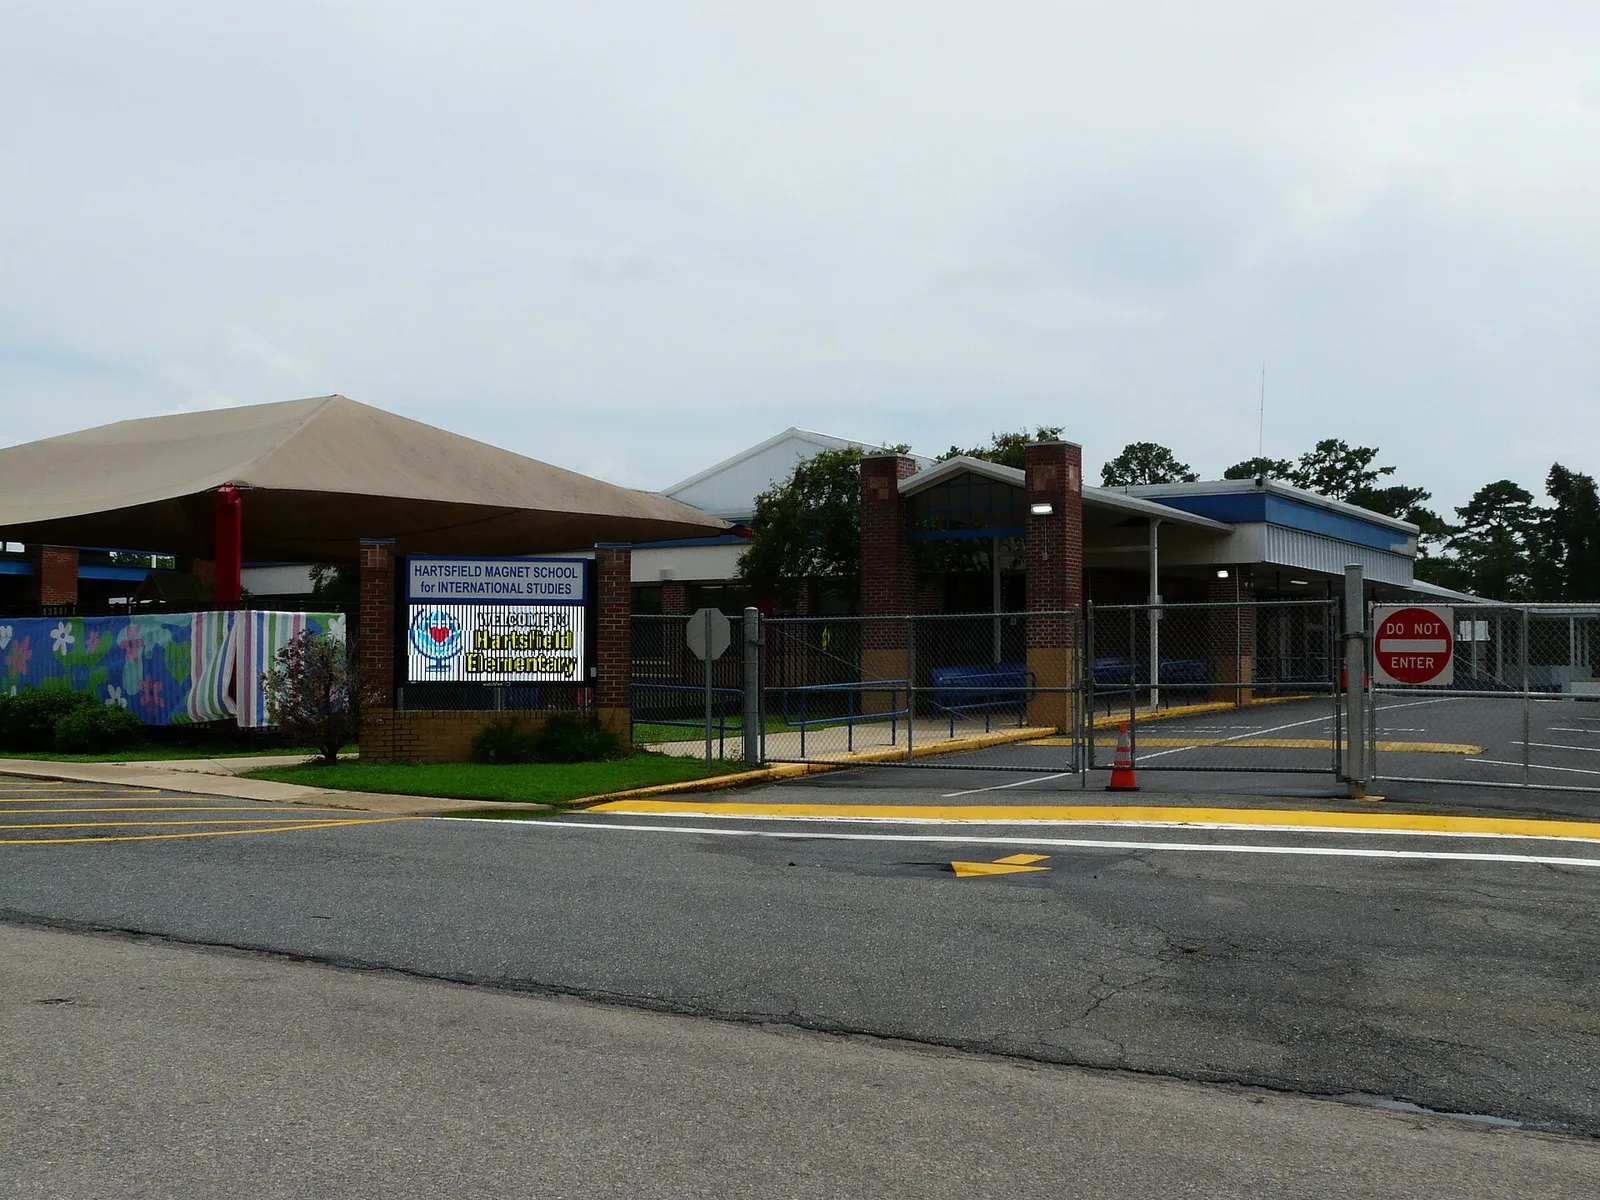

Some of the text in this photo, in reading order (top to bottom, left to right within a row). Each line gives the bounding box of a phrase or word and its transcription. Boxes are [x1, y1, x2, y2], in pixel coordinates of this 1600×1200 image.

[414, 564, 578, 579] HARTSFIELD MAGNET SCHOOL
[420, 581, 572, 594] for INTERNATIONAL STUDIES
[1386, 623, 1440, 635] DO NOT
[474, 629, 574, 651] Hartsfield
[466, 652, 578, 678] Elementary
[1391, 656, 1435, 669] ENTER
